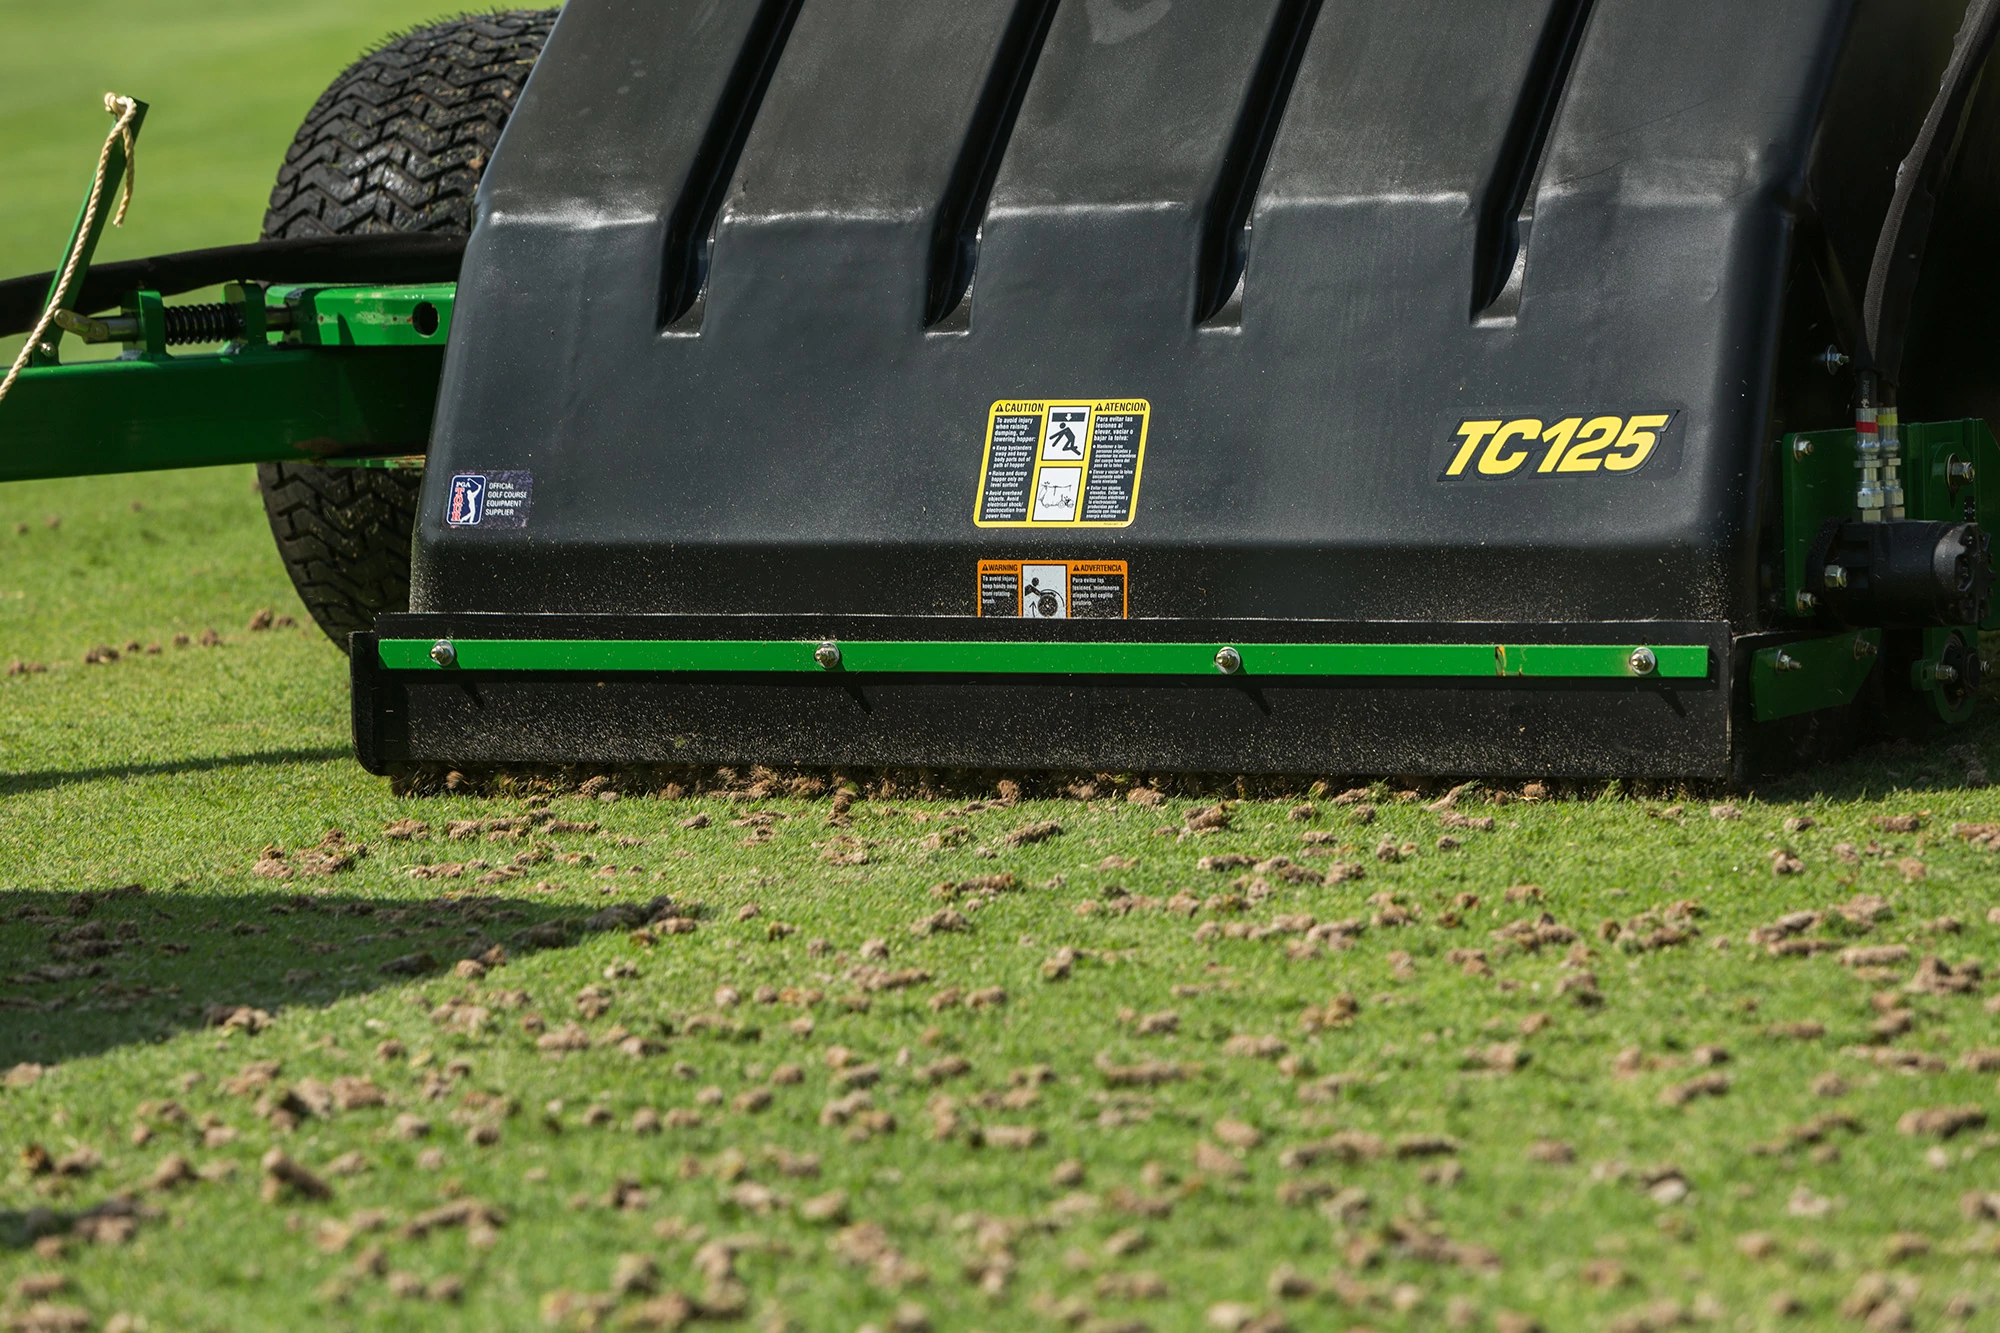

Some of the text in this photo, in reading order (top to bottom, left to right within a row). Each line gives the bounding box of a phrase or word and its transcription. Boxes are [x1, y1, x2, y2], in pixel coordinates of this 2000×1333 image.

[1004, 403, 1044, 412] CAUTION
[1446, 415, 1669, 475] TC125
[451, 487, 465, 521] TOUR
[1081, 564, 1122, 572] ADVERTENCIA
